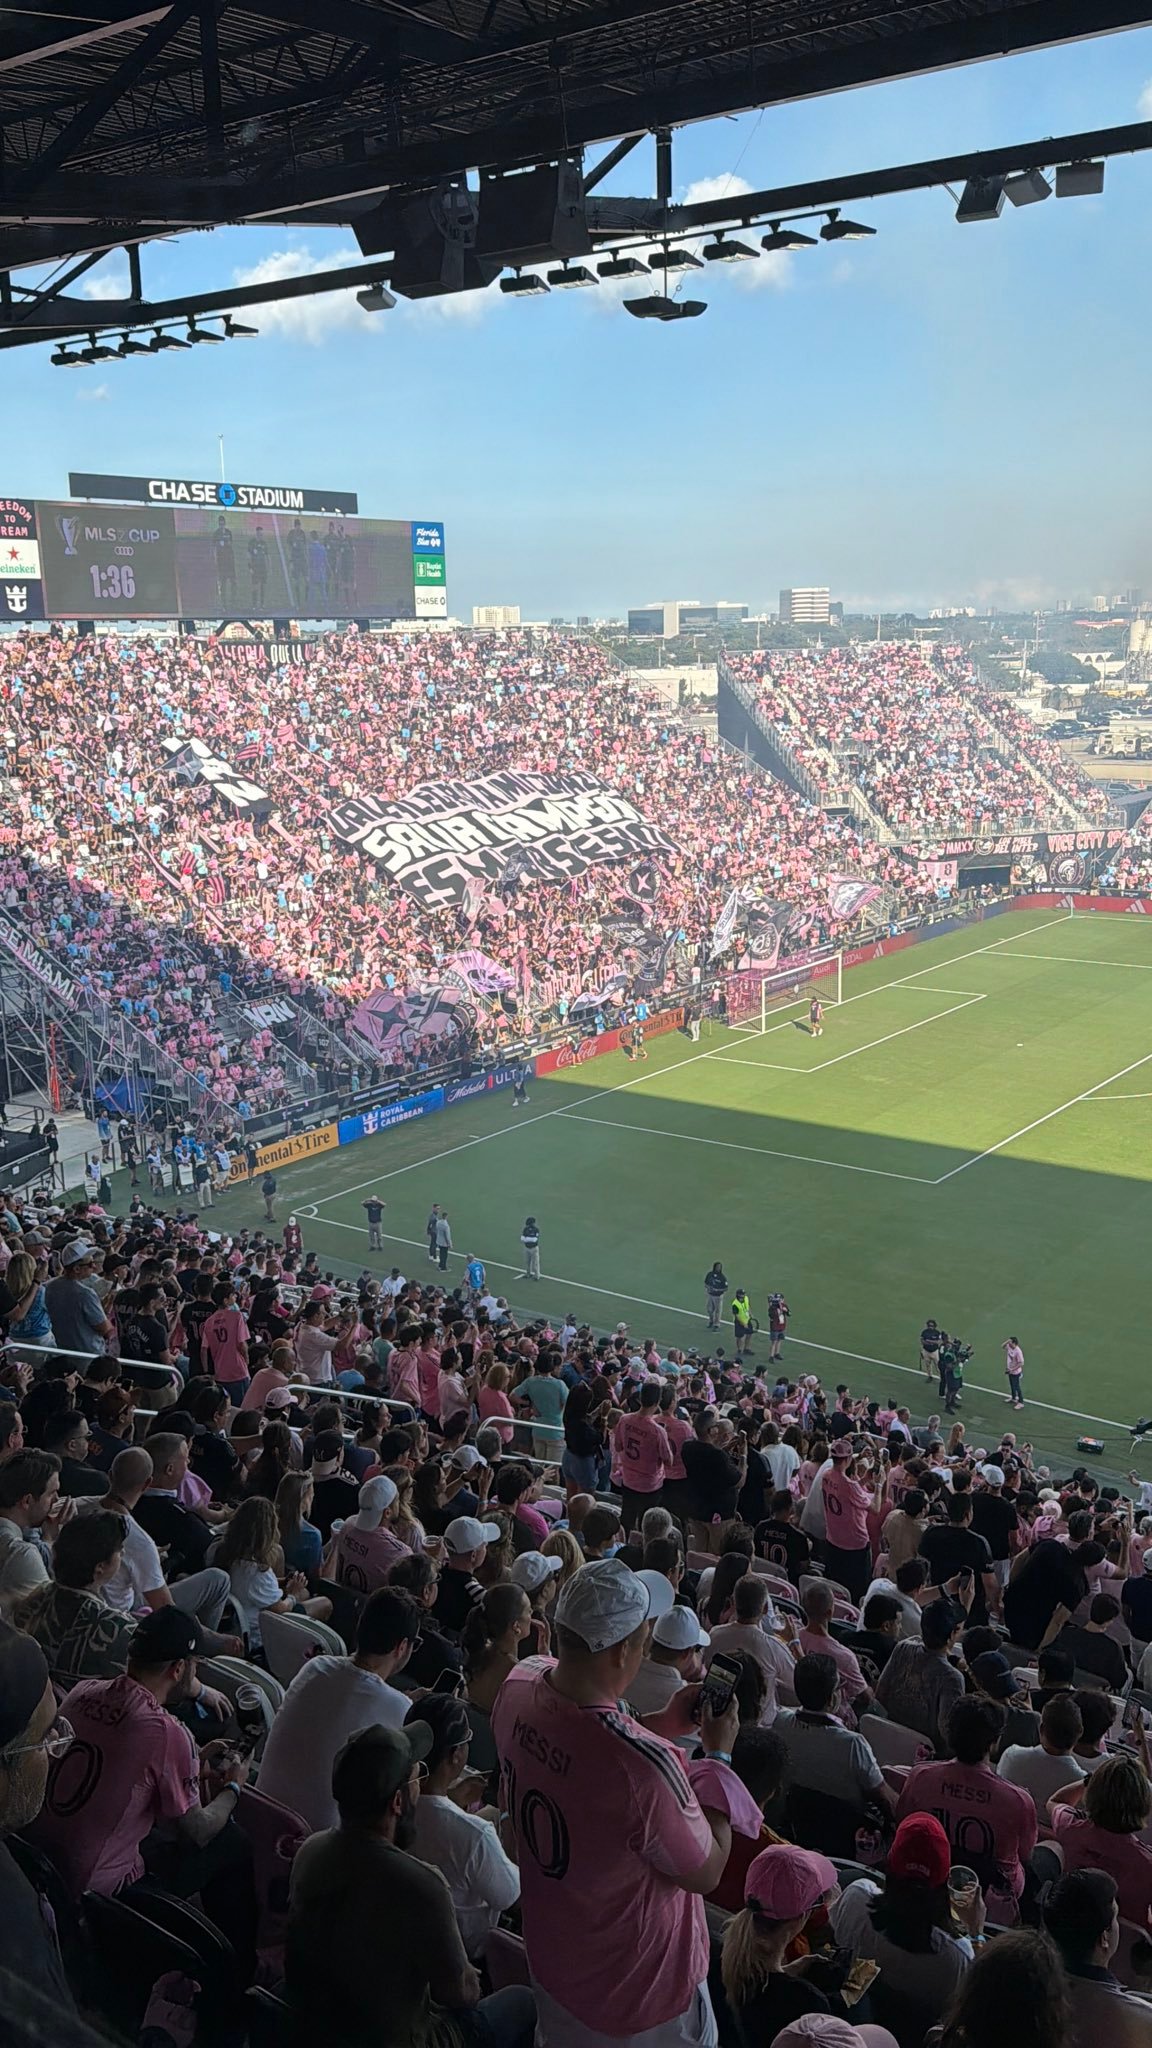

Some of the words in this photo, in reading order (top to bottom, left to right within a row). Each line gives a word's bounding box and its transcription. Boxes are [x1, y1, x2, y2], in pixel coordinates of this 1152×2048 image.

[148, 480, 218, 503] CHASE
[237, 487, 304, 508] STADIUM
[5, 515, 16, 524] TO
[84, 526, 117, 541] MLS
[128, 528, 160, 543] CUP
[416, 527, 440, 537] Florida
[416, 537, 430, 546] Blue
[89, 565, 136, 599] 1:36
[416, 597, 439, 605] CHASE
[1047, 834, 1076, 853] VICE
[1076, 832, 1106, 850] CITY
[400, 858, 467, 908] ES
[22, 943, 76, 1000] MIAMI
[447, 1079, 486, 1102] Michelob
[495, 1065, 533, 1085] ULTA
[380, 1105, 405, 1118] ROYAL
[380, 1106, 424, 1128] CARIBBEAN
[303, 1132, 330, 1151] Tire
[625, 1437, 641, 1461] 5
[822, 1488, 842, 1516] 10
[344, 1533, 369, 1558] MESSI
[764, 1529, 788, 1541] MESSI
[761, 1540, 788, 1567] 10
[72, 1693, 129, 1728] MESSI
[511, 1714, 572, 1777] MESSI
[941, 1782, 992, 1804] MESSI
[502, 1756, 571, 1881] 10
